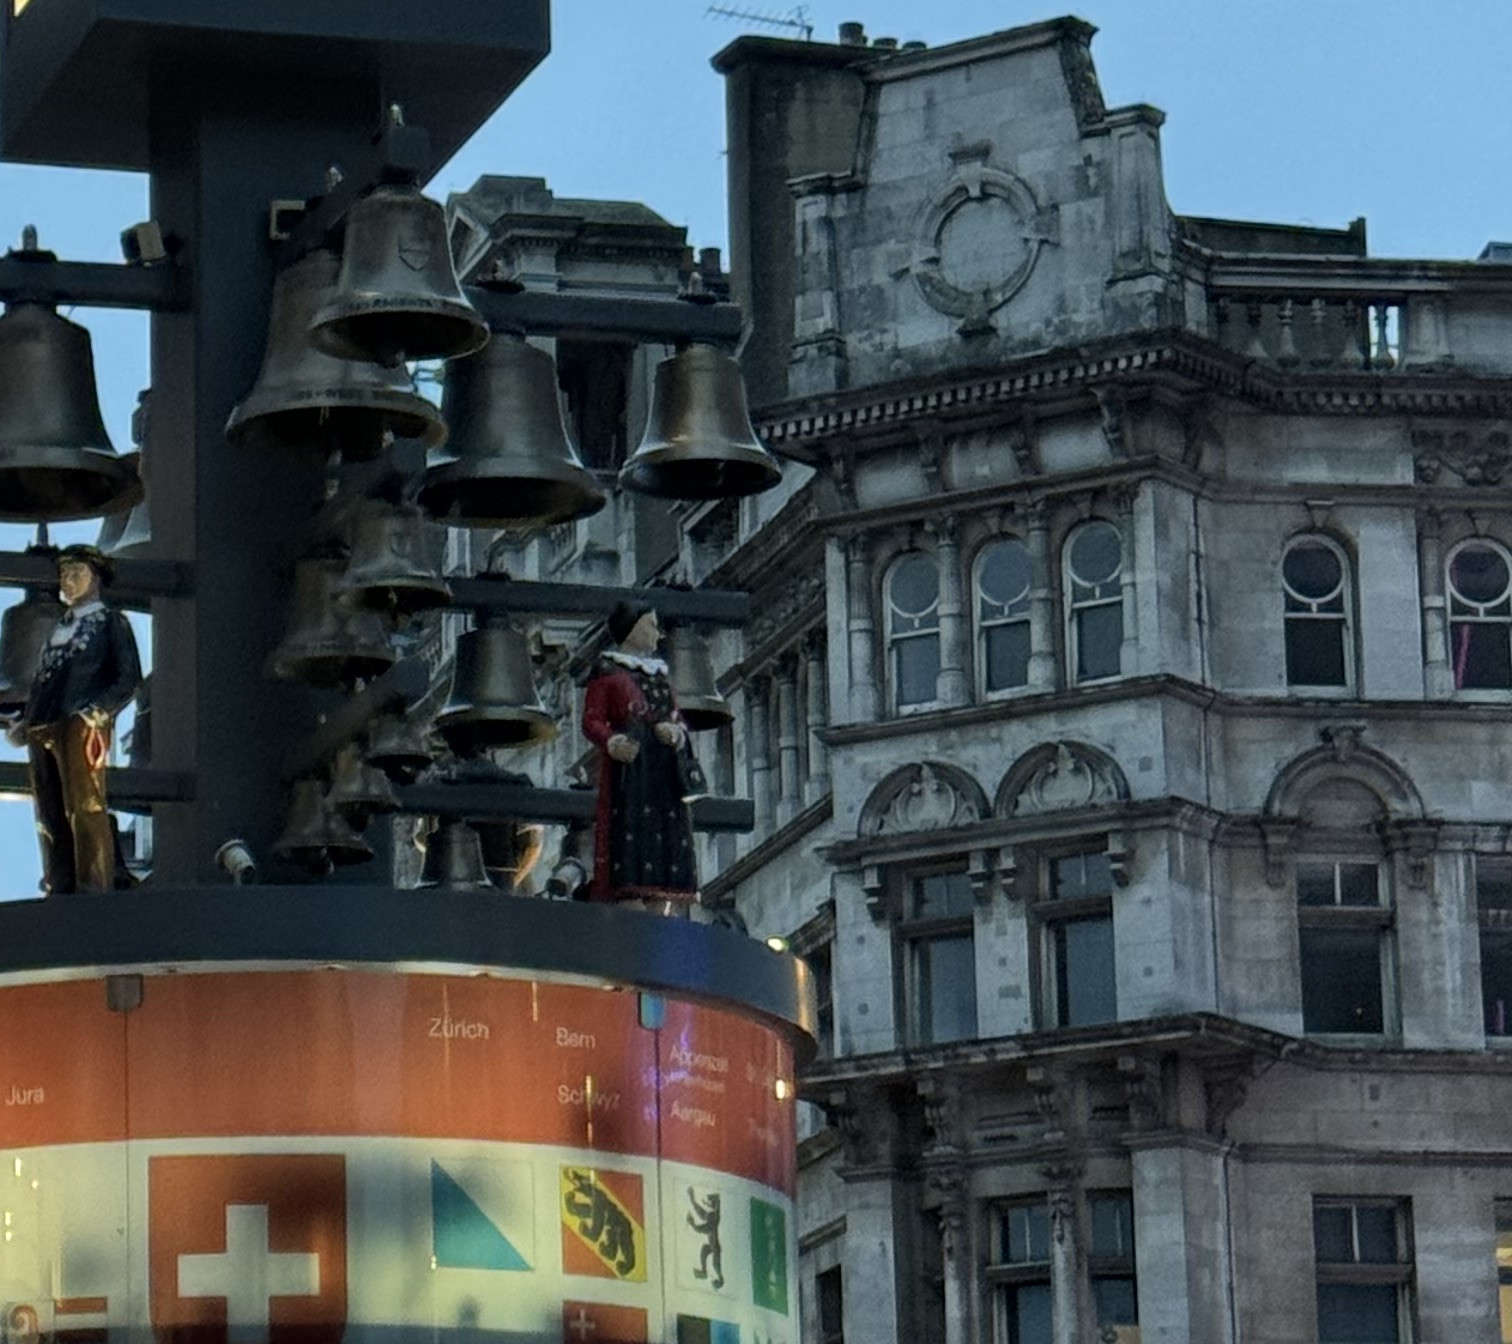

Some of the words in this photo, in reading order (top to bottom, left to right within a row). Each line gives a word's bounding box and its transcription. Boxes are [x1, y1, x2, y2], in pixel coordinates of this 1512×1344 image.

[429, 1017, 489, 1039] Zürich
[555, 1027, 596, 1050] Bern
[6, 1085, 45, 1107] Jura
